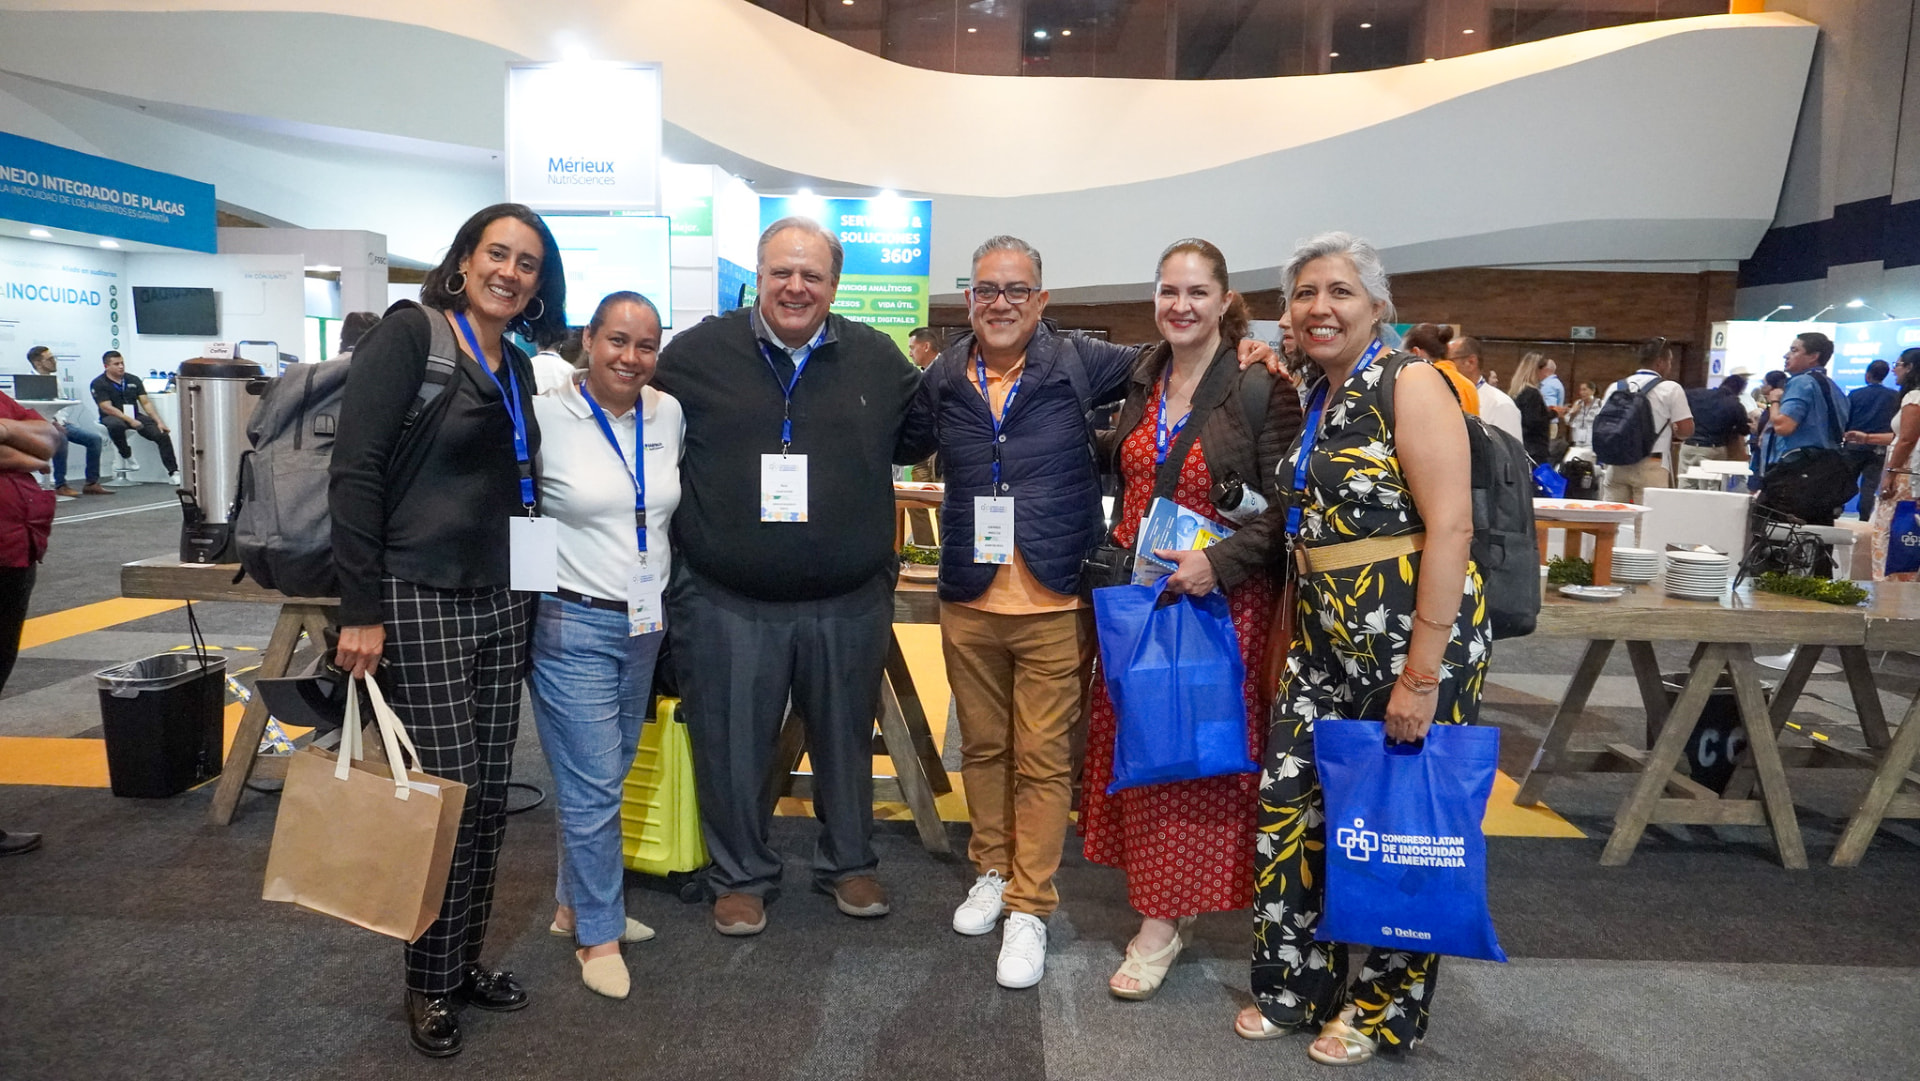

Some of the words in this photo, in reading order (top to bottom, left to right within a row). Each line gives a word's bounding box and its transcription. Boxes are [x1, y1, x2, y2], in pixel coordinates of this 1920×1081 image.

[548, 156, 615, 173] Mérieux
[548, 174, 616, 185] NutriSciences
[0, 164, 39, 187] NEJO
[42, 174, 120, 204] INTEGRADO
[122, 191, 140, 208] DE
[141, 196, 185, 217] PLAGAS
[11, 185, 58, 203] INOCUIDAD
[59, 194, 71, 206] DE
[71, 197, 87, 209] LOS
[87, 201, 127, 216] ALIMENTOS
[911, 216, 923, 228] &
[840, 231, 920, 245] SOLUCIONES
[6, 281, 102, 306] INOCUIDAD
[868, 283, 913, 293] ANALÍTICOS
[877, 301, 896, 309] VIDA
[896, 300, 914, 309] ÚTIL
[877, 316, 916, 324] DIGITALES
[1381, 833, 1431, 845] CONGRESO
[1432, 836, 1464, 846] LATAM
[1381, 843, 1397, 854] DE
[1399, 844, 1466, 857] INOCUIDAD
[1382, 853, 1466, 868] ALIMENTARIA
[1394, 927, 1431, 940] Delcen
